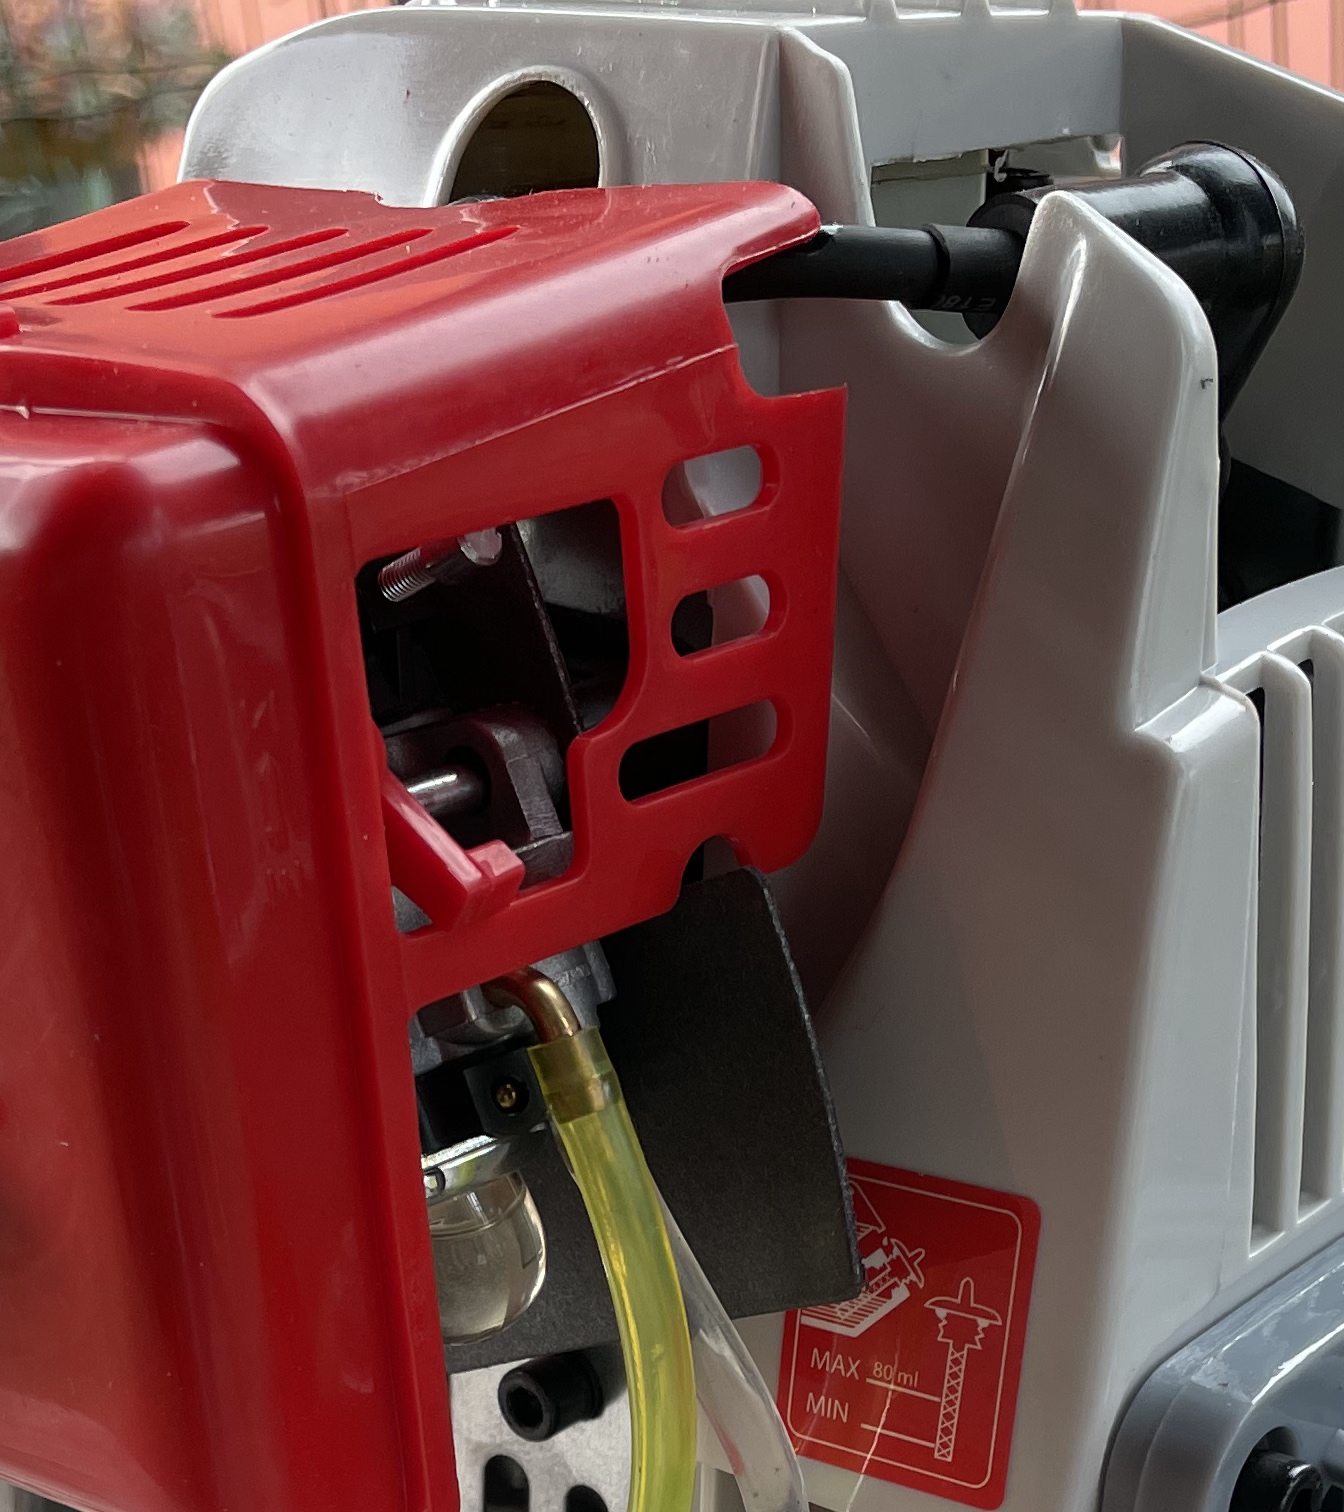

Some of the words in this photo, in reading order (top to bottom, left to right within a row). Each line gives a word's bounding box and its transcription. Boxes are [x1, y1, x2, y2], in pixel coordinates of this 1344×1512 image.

[810, 1347, 861, 1380] MAX
[872, 1361, 893, 1381] 80
[897, 1371, 919, 1388] ml
[805, 1392, 849, 1424] MIN
